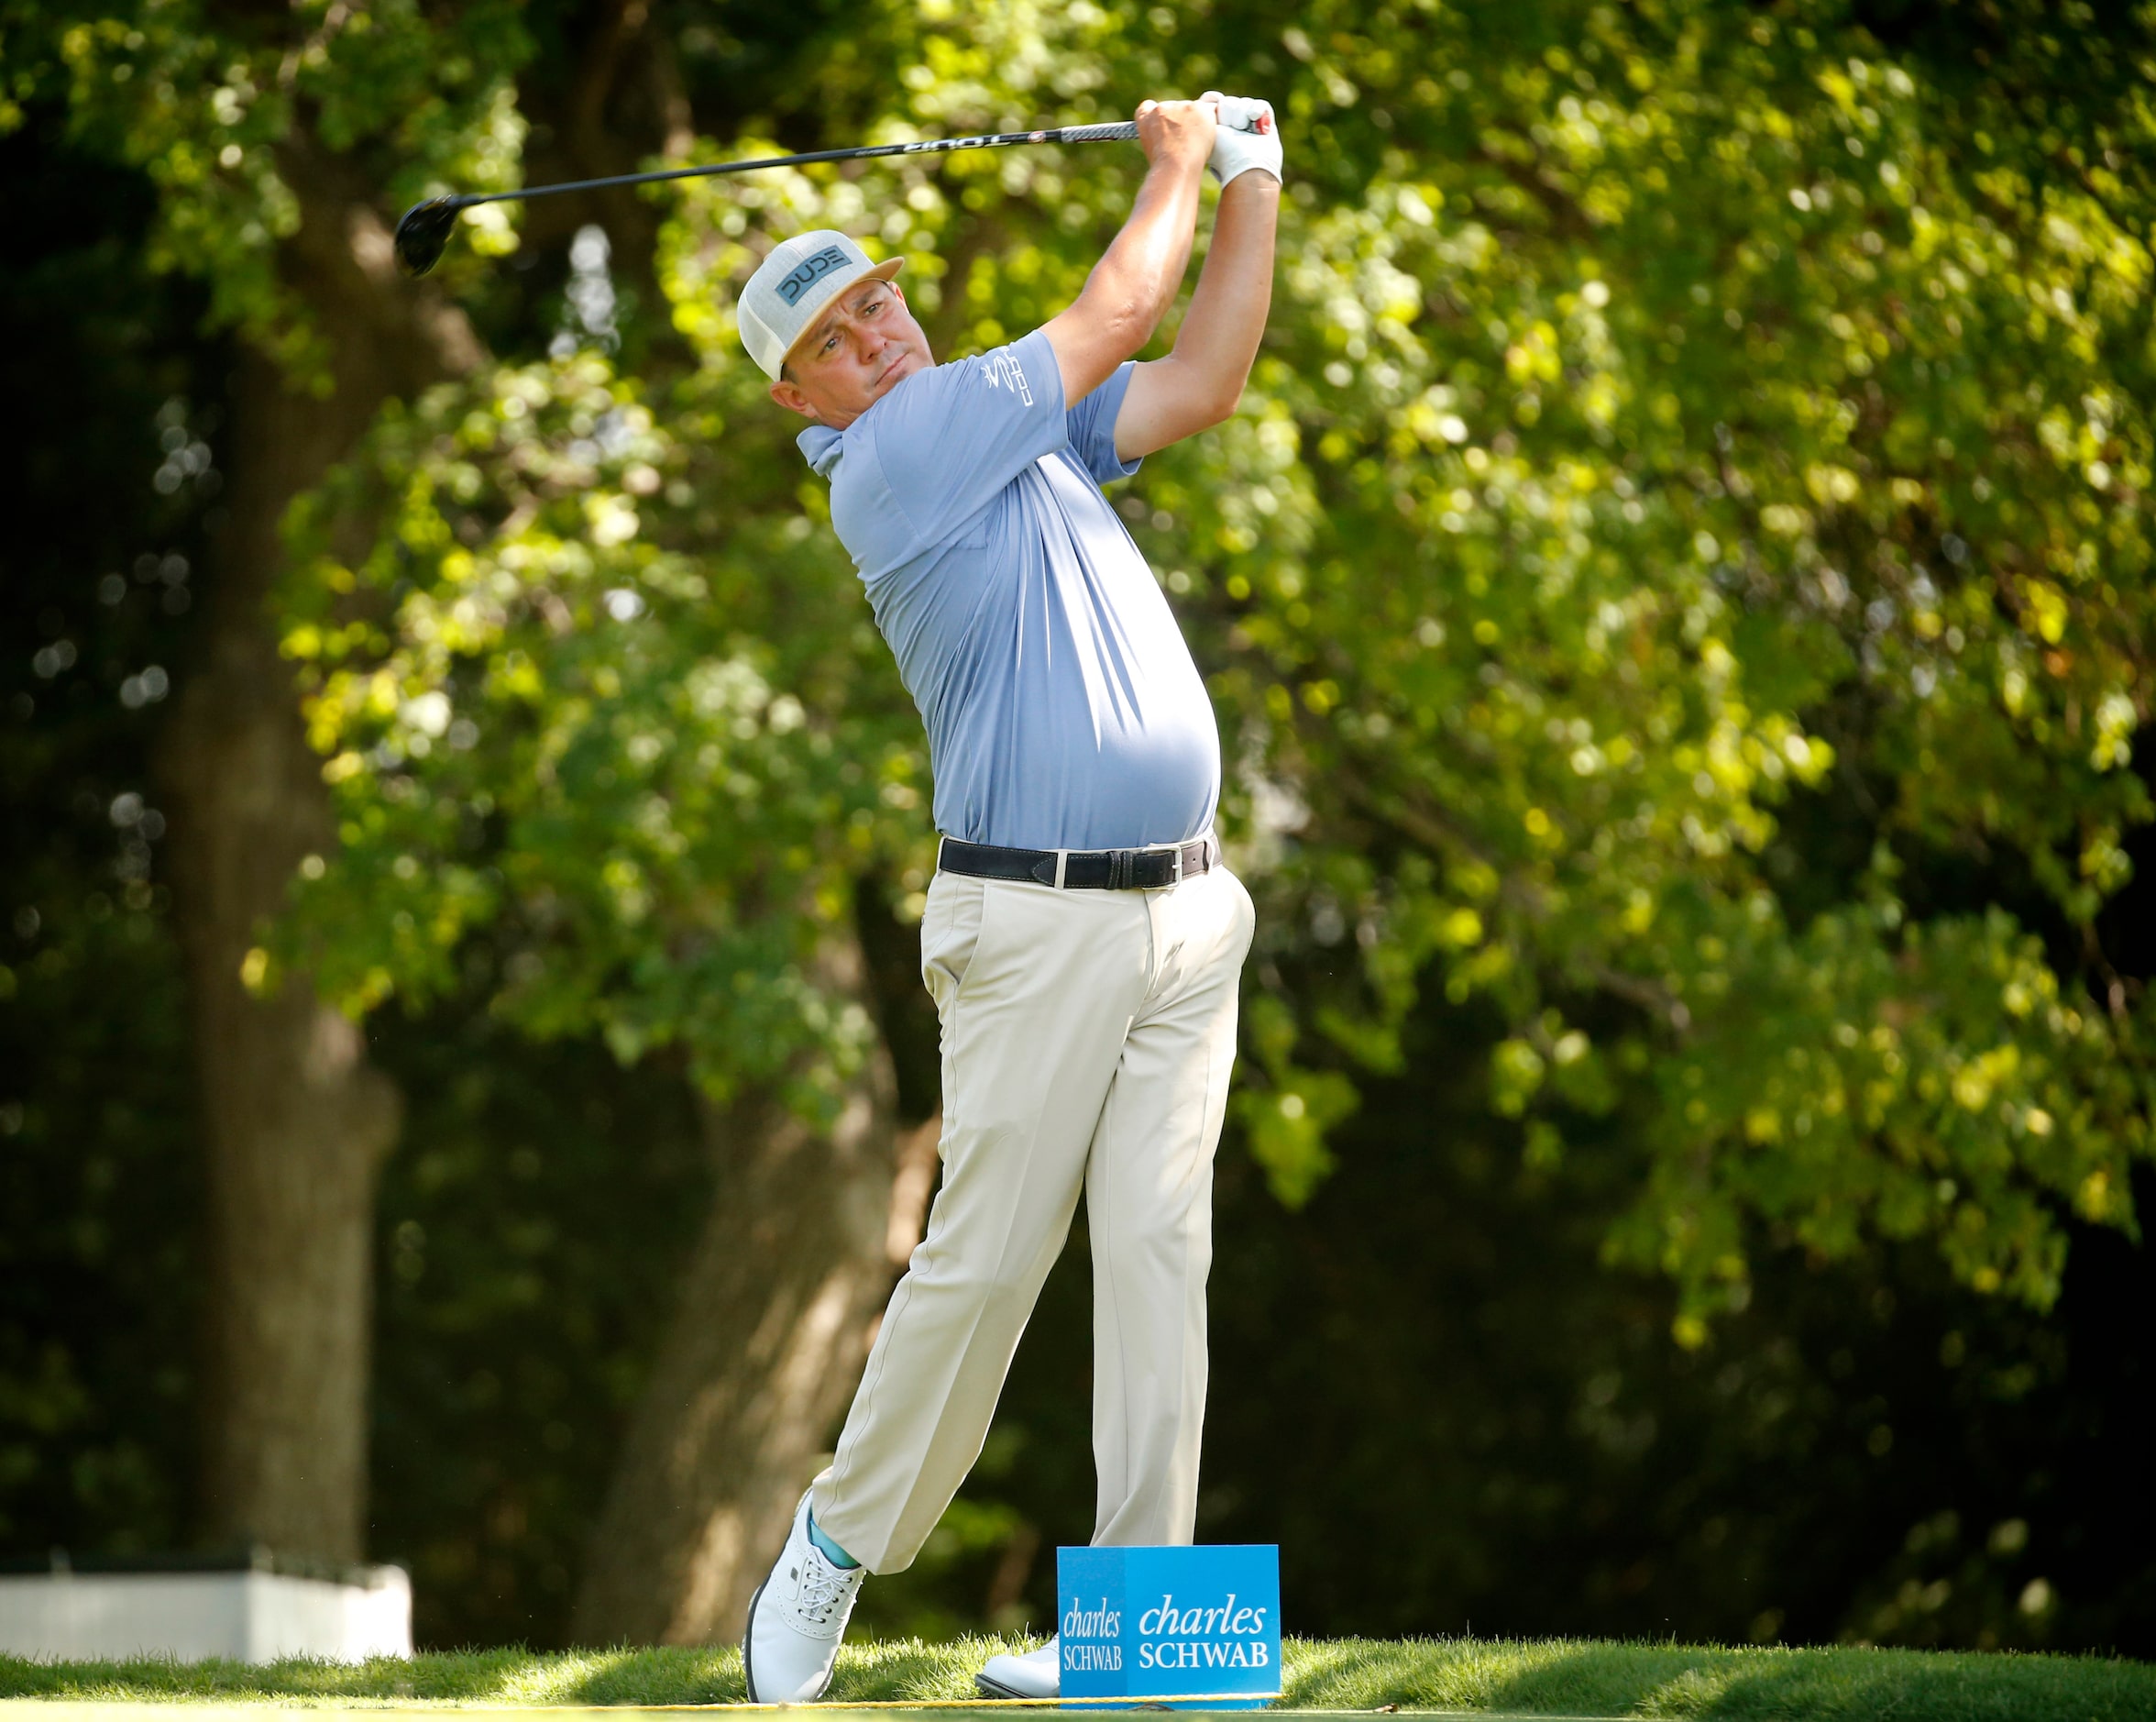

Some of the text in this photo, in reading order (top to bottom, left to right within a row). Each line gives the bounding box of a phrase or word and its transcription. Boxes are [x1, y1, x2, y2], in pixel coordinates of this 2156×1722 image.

[781, 249, 845, 299] DUDE
[1063, 1597, 1120, 1638] charles
[1138, 1594, 1267, 1636] charles
[1063, 1645, 1122, 1672] SCHWAB
[1138, 1641, 1269, 1669] SCHWAB
